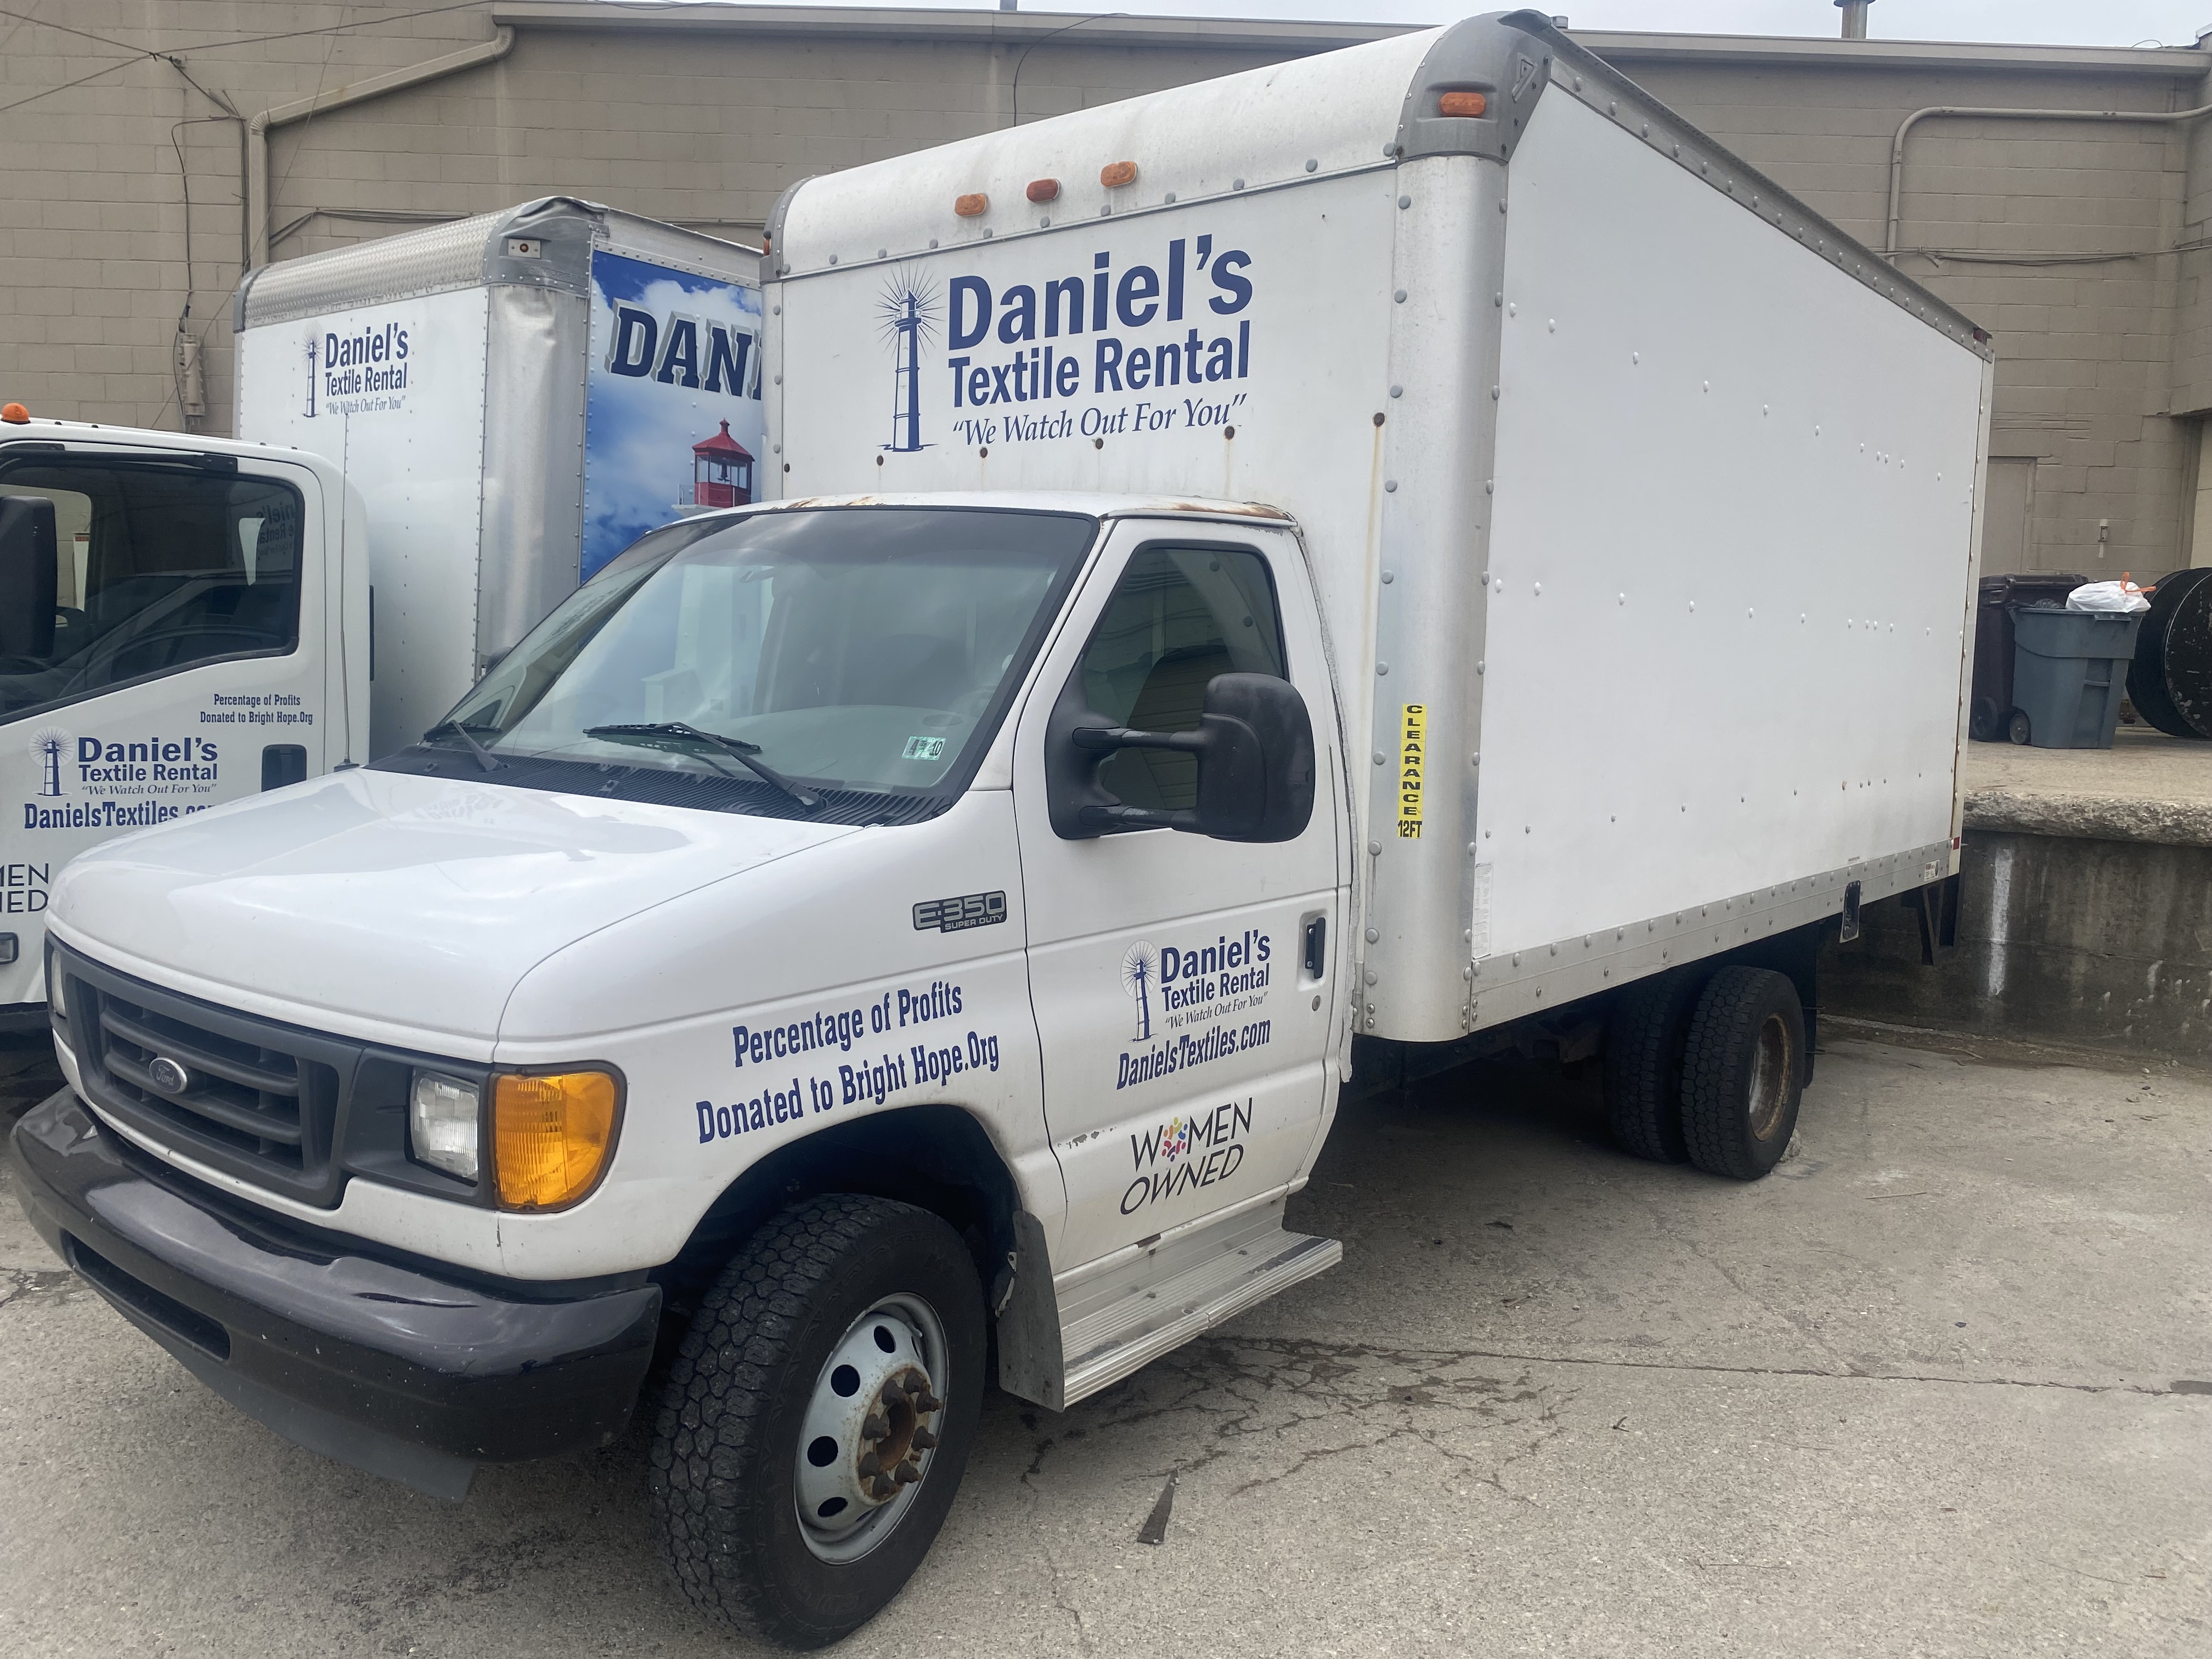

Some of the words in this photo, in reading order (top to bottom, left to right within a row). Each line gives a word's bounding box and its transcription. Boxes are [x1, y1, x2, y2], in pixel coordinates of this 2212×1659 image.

[948, 234, 1253, 351] Daniel's
[325, 322, 408, 369] Daniel's
[604, 297, 761, 400] DAN
[949, 346, 1079, 408] Textile
[1094, 320, 1250, 393] Rental
[325, 369, 362, 397] Textile
[365, 362, 407, 392] Rental
[360, 398, 374, 412] Out
[375, 397, 387, 410] For
[1003, 409, 1073, 443] Watch
[1080, 407, 1128, 436] Out
[1132, 403, 1177, 432] For
[200, 712, 235, 723] Donated
[238, 713, 246, 723] to
[249, 712, 274, 725] Bright
[276, 712, 313, 725] Hope.Org
[214, 693, 261, 708] Percentage
[263, 694, 272, 706] of
[274, 695, 301, 706] Profits
[78, 737, 218, 763] Daniel's
[1402, 705, 1423, 815] CLEARANCE
[78, 764, 146, 782] Textile
[154, 763, 217, 781] Rental
[109, 785, 144, 794] Watch
[148, 784, 168, 794] Out
[171, 784, 189, 794] For
[24, 800, 215, 830] DanielsTextiles
[1397, 820, 1423, 838] 12FT
[945, 918, 977, 930] SUPER
[979, 914, 1003, 924] DUTY
[1161, 929, 1270, 984] Daniel's
[1161, 978, 1215, 1012] Textile
[1220, 963, 1269, 997] Rental
[732, 1008, 864, 1068] Percentage
[871, 992, 891, 1034] of
[896, 980, 962, 1027] Profits
[1186, 1006, 1212, 1025] Watch
[1215, 1001, 1232, 1016] Out
[1232, 998, 1247, 1012] For
[1116, 1019, 1271, 1090] DanielsTextiles.com
[156, 1064, 175, 1086] Ford
[696, 1077, 803, 1144] Donated
[810, 1076, 833, 1113] to
[838, 1053, 908, 1105] Bright
[911, 1030, 1000, 1086] Hope.Org
[1120, 1144, 1244, 1215] OWNED
